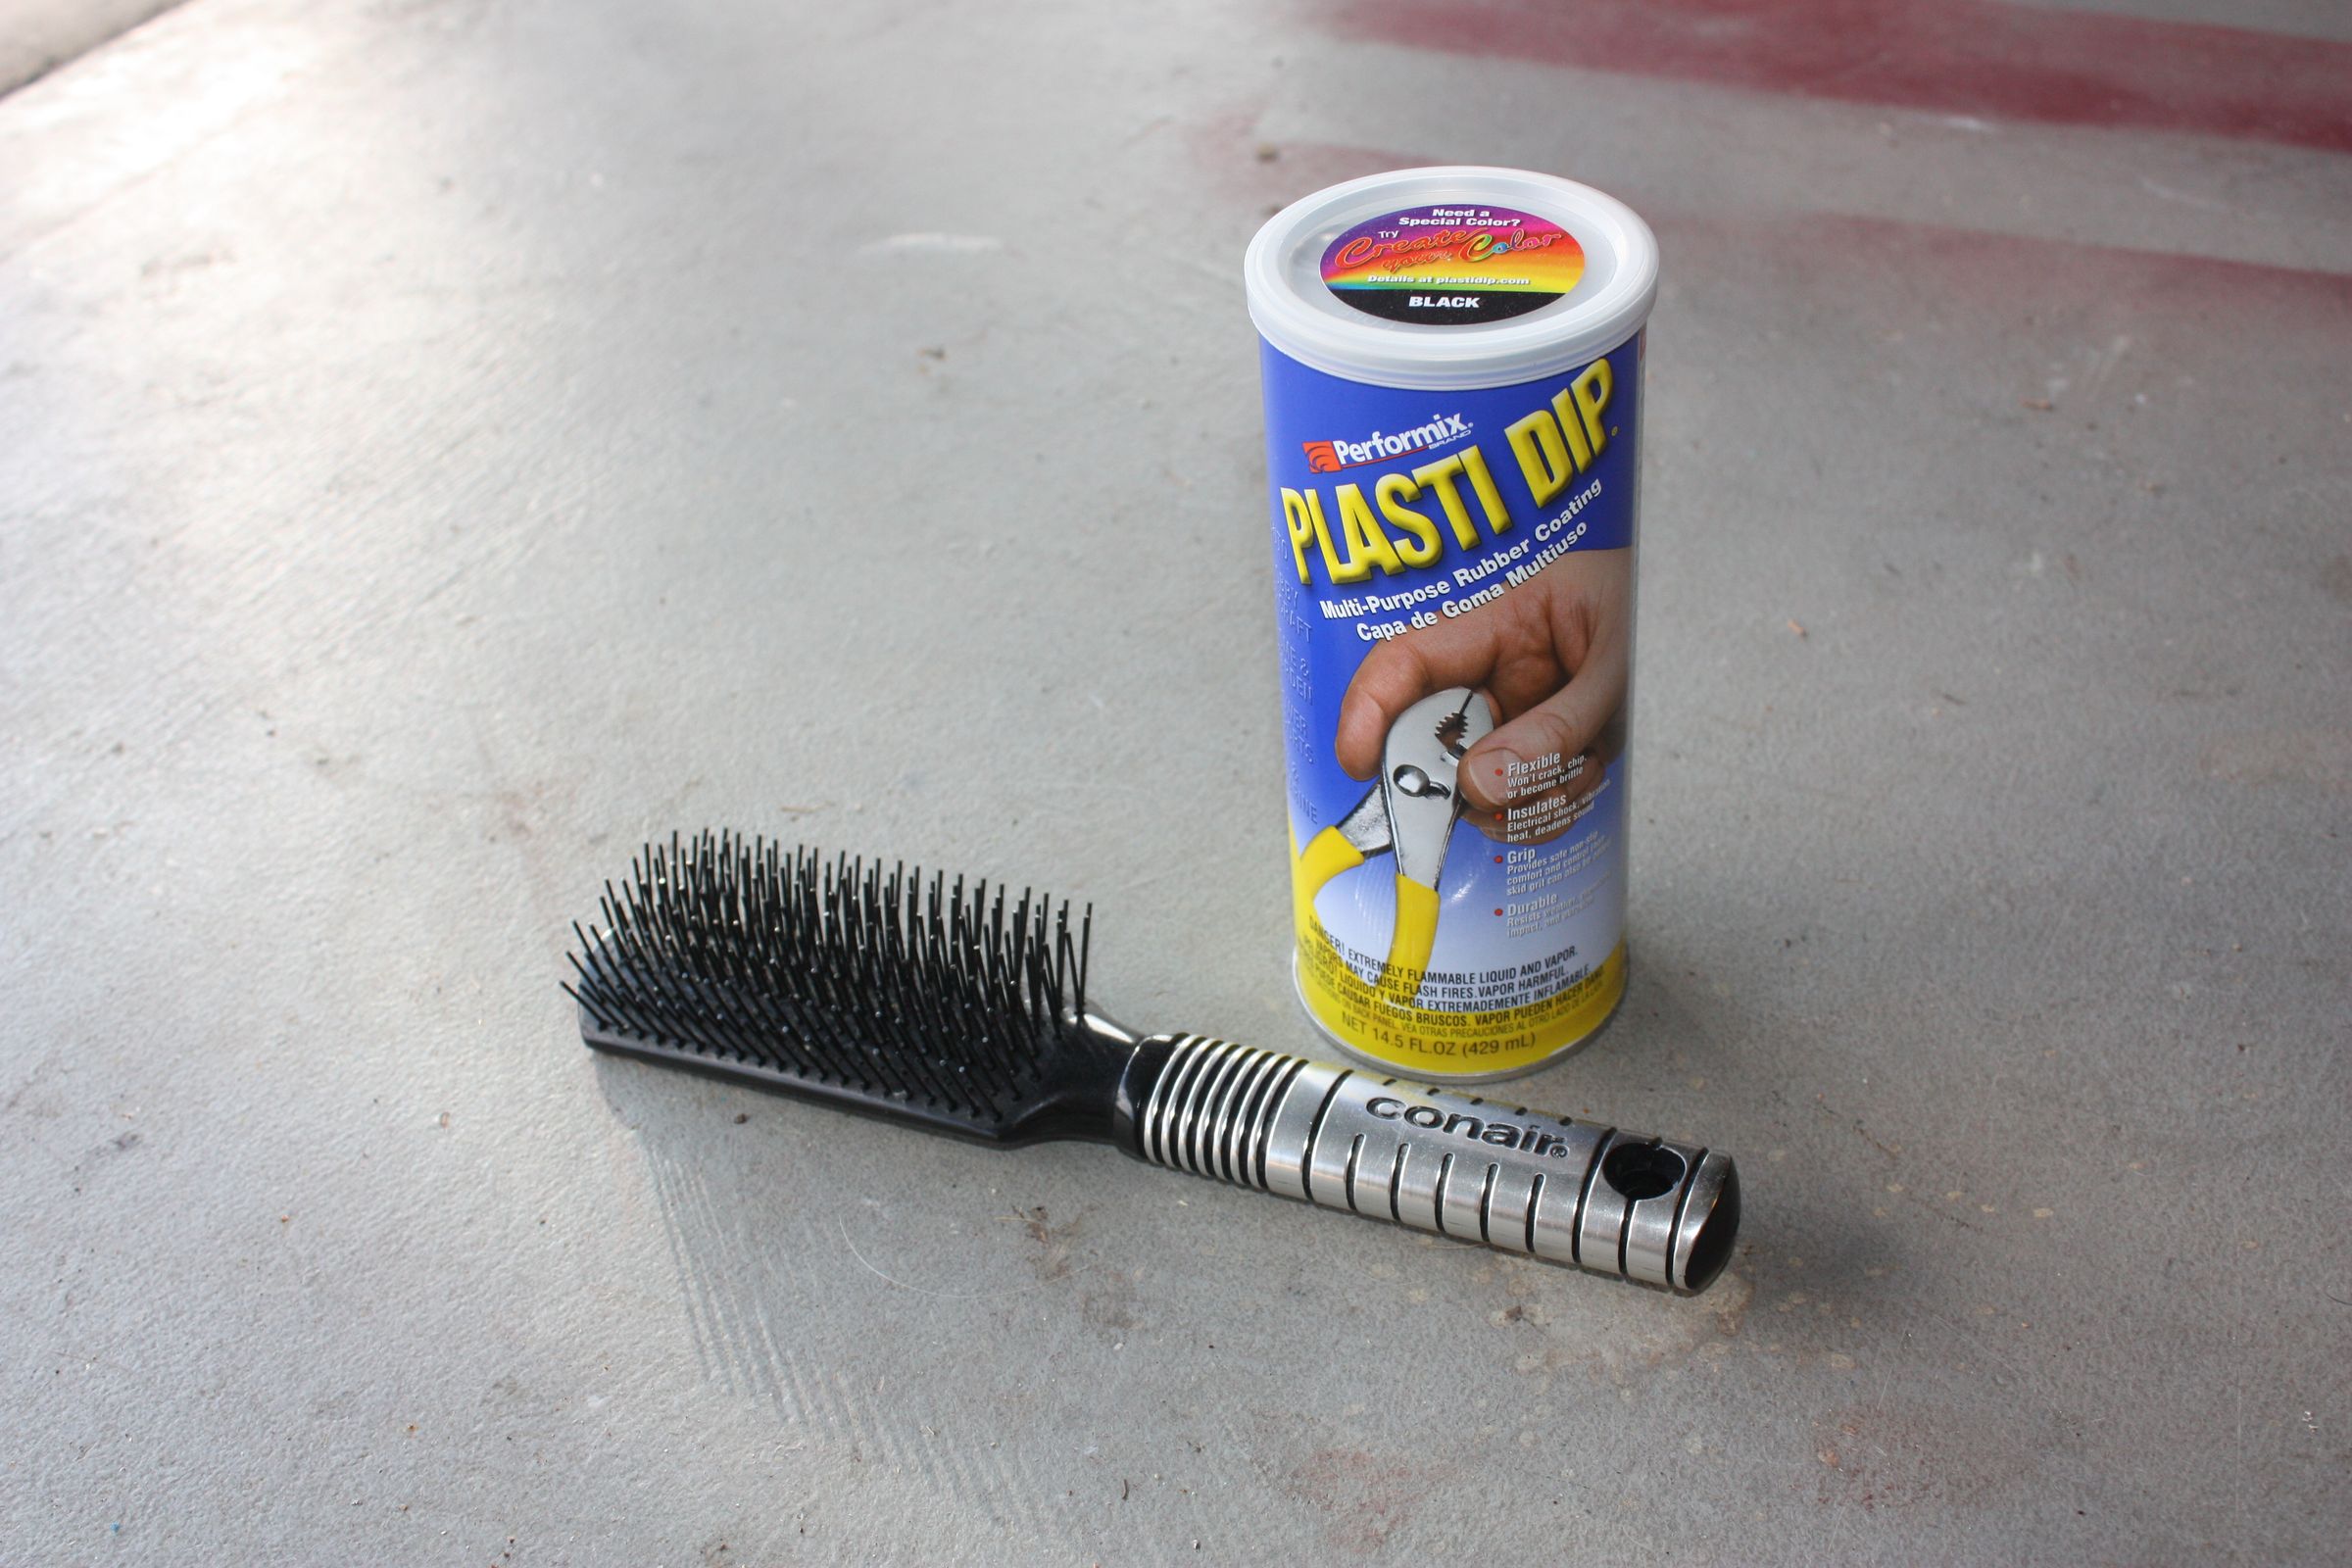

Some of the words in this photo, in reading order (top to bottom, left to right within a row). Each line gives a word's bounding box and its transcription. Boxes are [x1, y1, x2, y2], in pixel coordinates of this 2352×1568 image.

[1398, 217, 1462, 227] Special
[1466, 218, 1521, 227] Color?
[1432, 209, 1476, 218] Need
[1378, 229, 1398, 239] Try
[1458, 227, 1561, 263] Color
[1335, 227, 1489, 269] Create
[1381, 250, 1453, 273] your
[1367, 274, 1416, 284] Details
[1418, 275, 1434, 284] at
[1436, 275, 1531, 286] plastidip.com
[1408, 296, 1481, 309] BLACK
[1428, 429, 1473, 451] BRAND
[1280, 444, 1513, 586] PLASTI
[1504, 358, 1614, 510] DIP
[1319, 579, 1451, 621] Multi-Purpose
[1452, 539, 1531, 587] Rubber
[1535, 478, 1603, 543] Coating
[1356, 614, 1407, 642] Capa
[1411, 606, 1439, 629] de
[1442, 582, 1504, 619] Goma
[1505, 521, 1589, 590] Multiuso
[1507, 753, 1561, 776] Flexible
[1507, 772, 1536, 788] Won't
[1507, 789, 1518, 800] or
[1520, 779, 1557, 796] become
[1559, 766, 1584, 784] brittle
[1507, 794, 1567, 821] Insulates
[1535, 815, 1572, 836] deadens
[1573, 801, 1594, 821] sound
[1507, 812, 1551, 832] Electrical
[1507, 848, 1536, 864] Grip
[1507, 858, 1547, 875] Provides
[1550, 849, 1568, 863] safe
[1506, 885, 1527, 896] skid
[1546, 873, 1562, 885] can
[1507, 868, 1543, 886] comfort
[1544, 862, 1561, 875] and
[1506, 910, 1542, 927] Resists
[1507, 894, 1558, 917] Durable
[1309, 915, 1345, 955] DANGER!
[1348, 948, 1404, 978] EXTREMELY
[1407, 968, 1476, 985] FLAMMABLE
[1479, 967, 1517, 984] LIQUID
[1520, 960, 1542, 977] AND
[1544, 945, 1578, 969] VAPOR.
[1346, 960, 1364, 978] MAY
[1367, 971, 1400, 992] CAUSE
[1403, 983, 1438, 998] FLASH
[1478, 982, 1515, 998] VAPOR
[1518, 965, 1569, 992] HARMFUL.
[1337, 983, 1371, 1009] CAUSAR
[1373, 1001, 1413, 1022] FUEGOS
[1416, 1013, 1471, 1028] BRUSCOS.
[1475, 1010, 1510, 1026] VAPOR
[1514, 999, 1553, 1020] PUEDEN
[1555, 982, 1583, 1005] HACER
[1340, 972, 1376, 998] LIQUIDO
[1379, 989, 1385, 1002] Y
[1389, 992, 1424, 1010] VAPOR
[1427, 994, 1531, 1013] EXTREMADEMENTE
[1342, 1010, 1367, 1035] NET
[1373, 1029, 1404, 1050] 14.5
[1462, 1035, 1499, 1058] (429
[1504, 1031, 1537, 1050] mL)
[1401, 1022, 1417, 1034] VEA
[1419, 1024, 1447, 1038] OTRAS
[1450, 1025, 1514, 1039] PRECAUCIONES
[1516, 1022, 1527, 1032] AL
[1529, 1013, 1550, 1028] OTRO
[1366, 1097, 1565, 1157] conair
